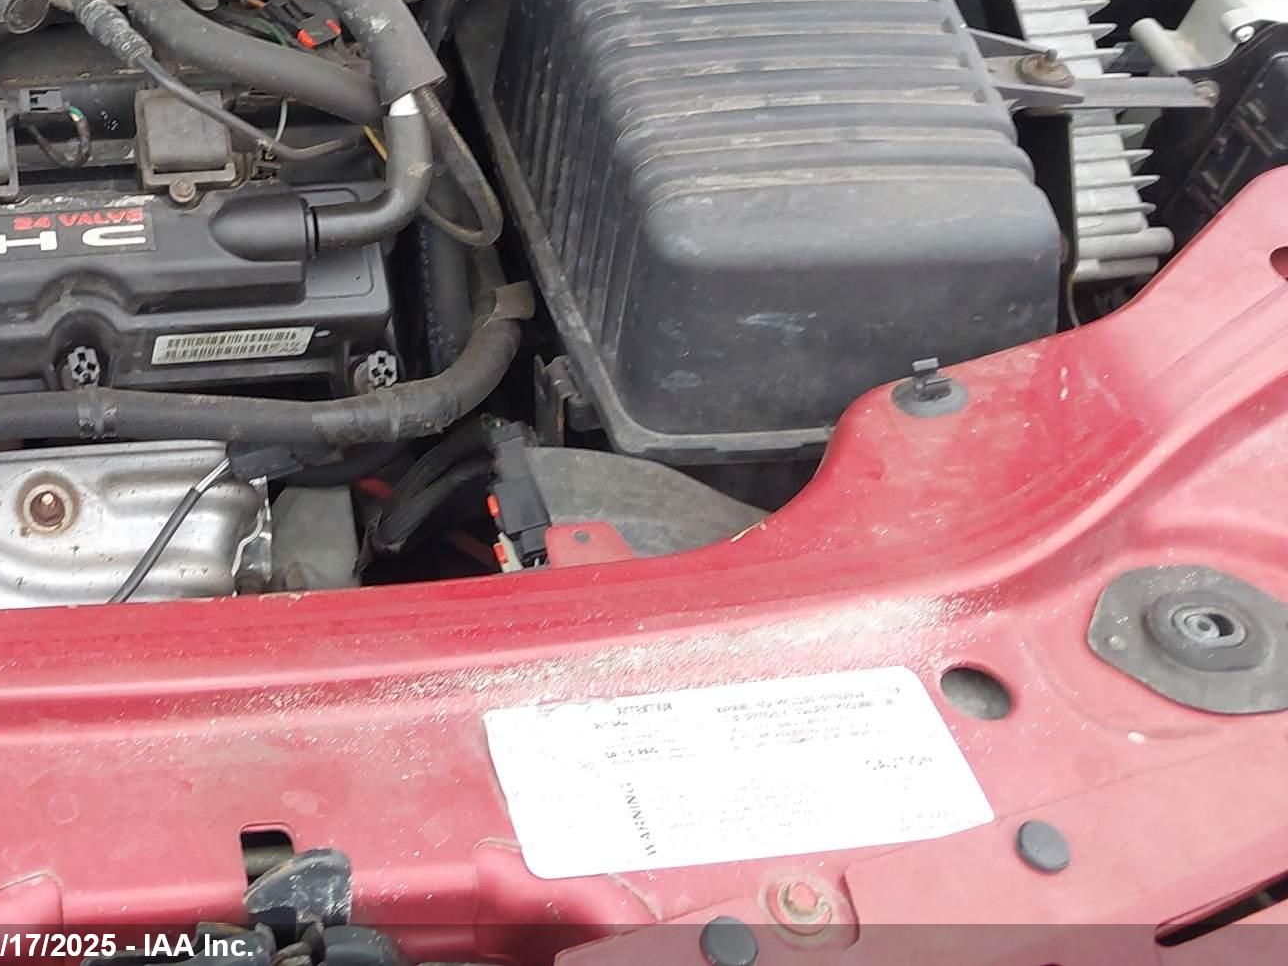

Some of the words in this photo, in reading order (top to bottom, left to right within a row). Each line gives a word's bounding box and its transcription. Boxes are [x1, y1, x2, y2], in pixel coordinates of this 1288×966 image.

[13, 215, 52, 232] 24
[58, 207, 144, 227] VALVE
[619, 781, 657, 857] WARNING
